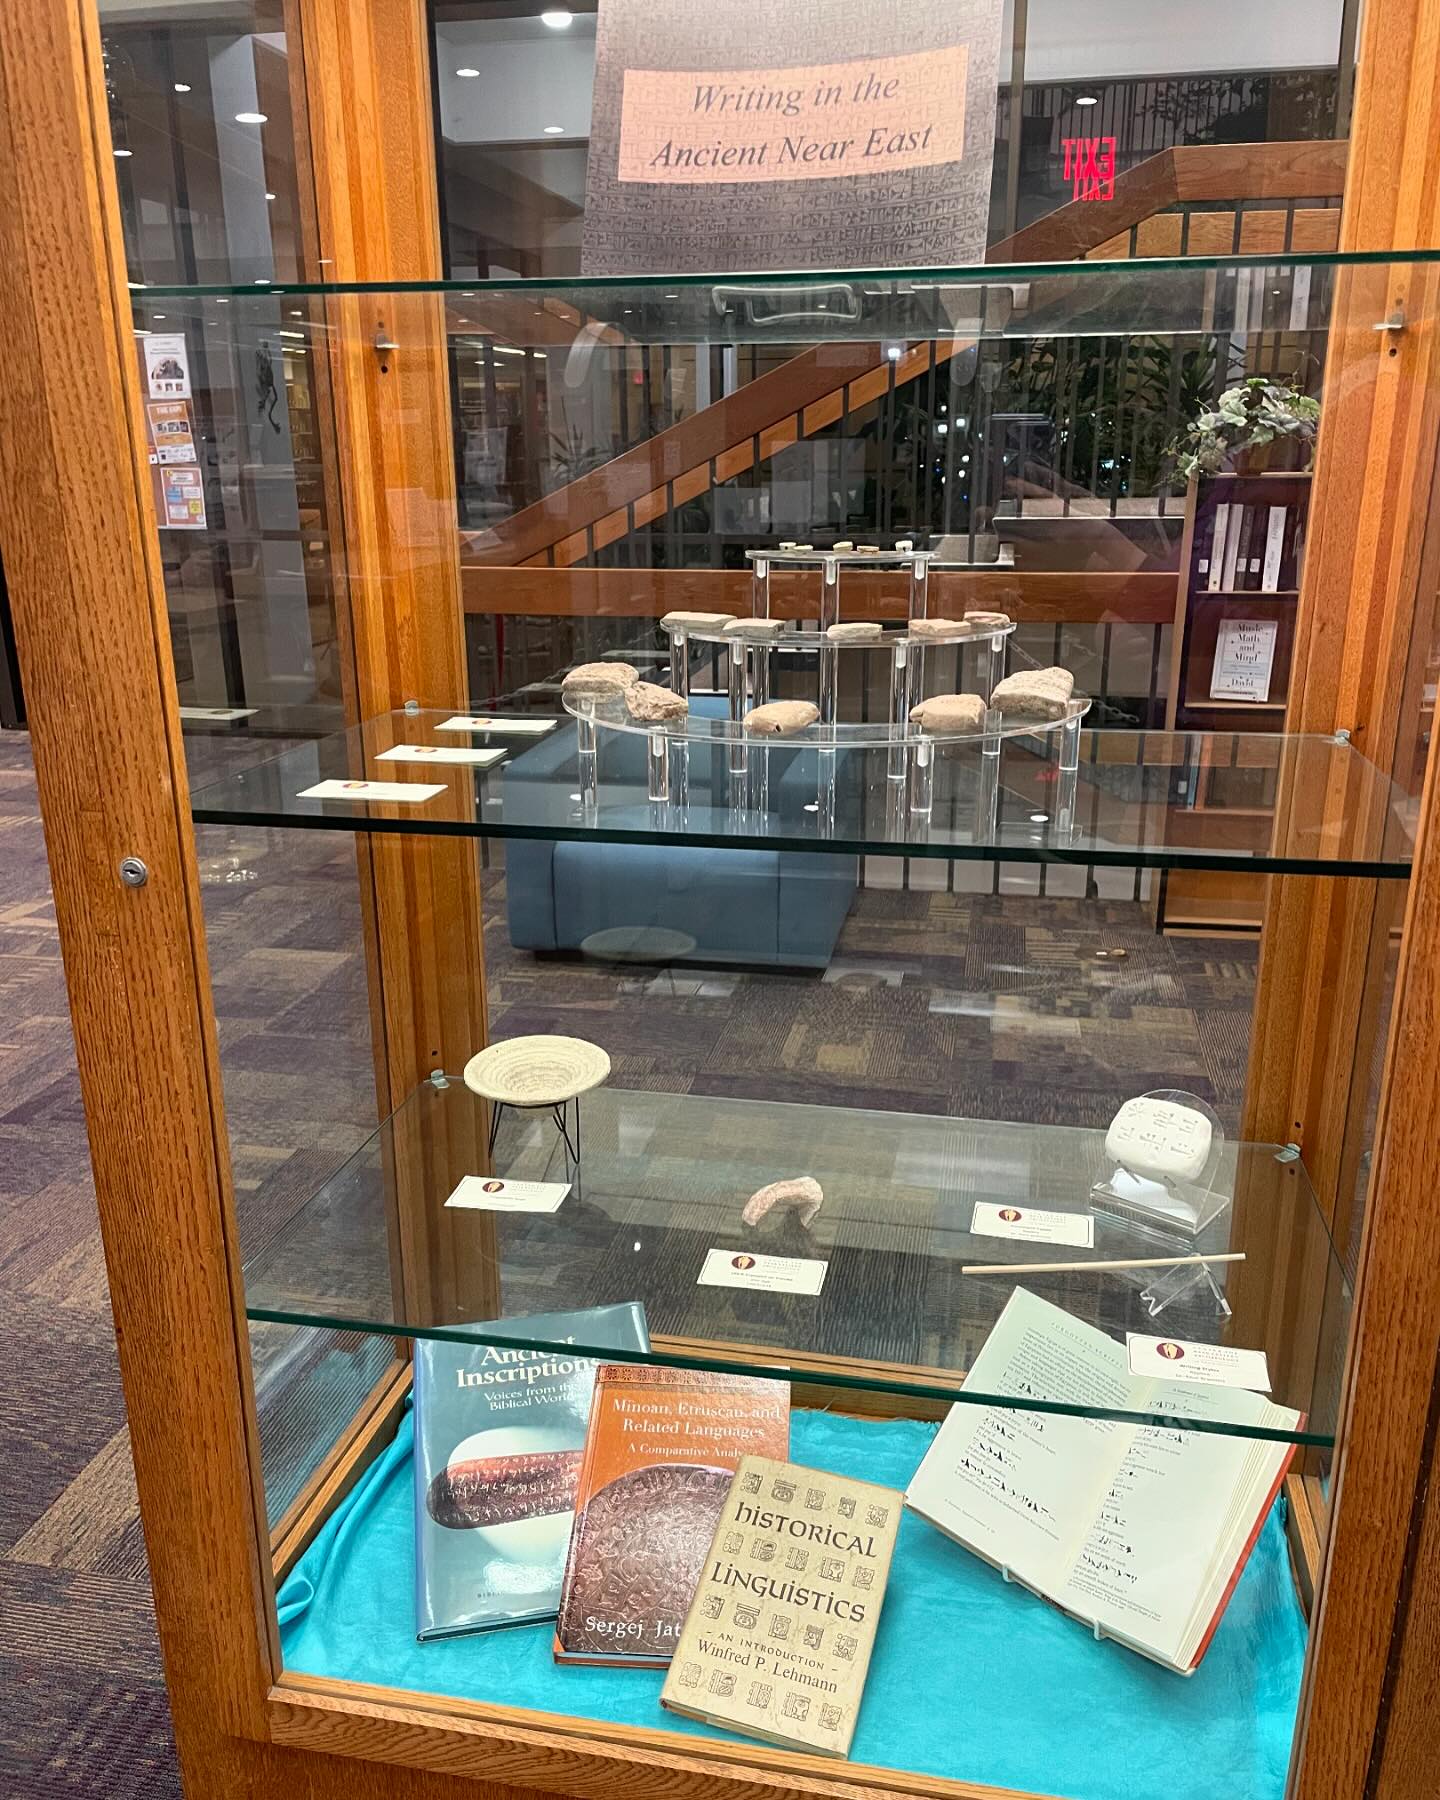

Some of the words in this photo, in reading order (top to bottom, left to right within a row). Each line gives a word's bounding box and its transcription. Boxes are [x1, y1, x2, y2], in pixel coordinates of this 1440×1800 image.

[692, 84, 803, 116] Writing
[812, 80, 842, 107] in
[852, 73, 900, 103] the
[650, 139, 768, 168] Ancient
[777, 134, 855, 164] Near
[862, 123, 933, 157] East
[484, 1390, 523, 1402] Voices
[526, 1385, 556, 1397] from
[489, 1396, 532, 1411] Biblical
[612, 1399, 673, 1416] Minoan,
[751, 1404, 782, 1419] and
[623, 1418, 681, 1433] Related
[684, 1422, 766, 1441] Languages
[628, 1442, 637, 1452] A
[640, 1443, 709, 1457] Comparative
[585, 1616, 643, 1639] Sergej
[718, 1632, 734, 1642] AN
[740, 1639, 826, 1670] INTRODUCTION
[698, 1639, 751, 1666] Winfred
[755, 1656, 767, 1672] P.
[773, 1662, 838, 1693] Lehmann
